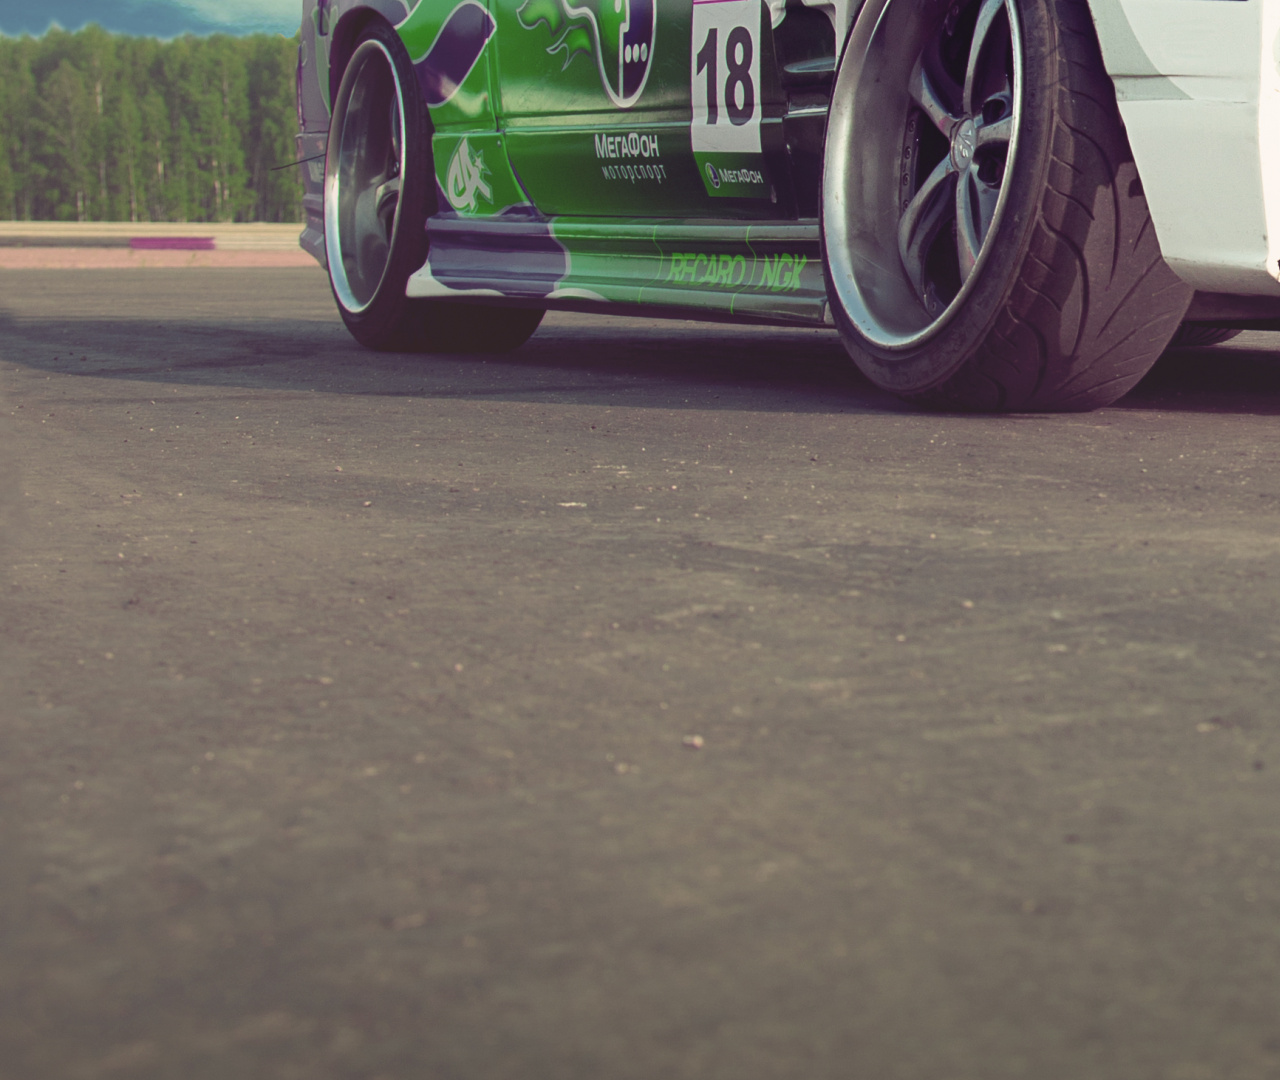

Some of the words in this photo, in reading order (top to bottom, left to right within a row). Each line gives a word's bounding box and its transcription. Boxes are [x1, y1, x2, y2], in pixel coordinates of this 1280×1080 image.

[696, 25, 755, 127] 18
[601, 164, 667, 184] моторспорт
[663, 252, 747, 288] RECARO
[755, 252, 808, 292] NGK
